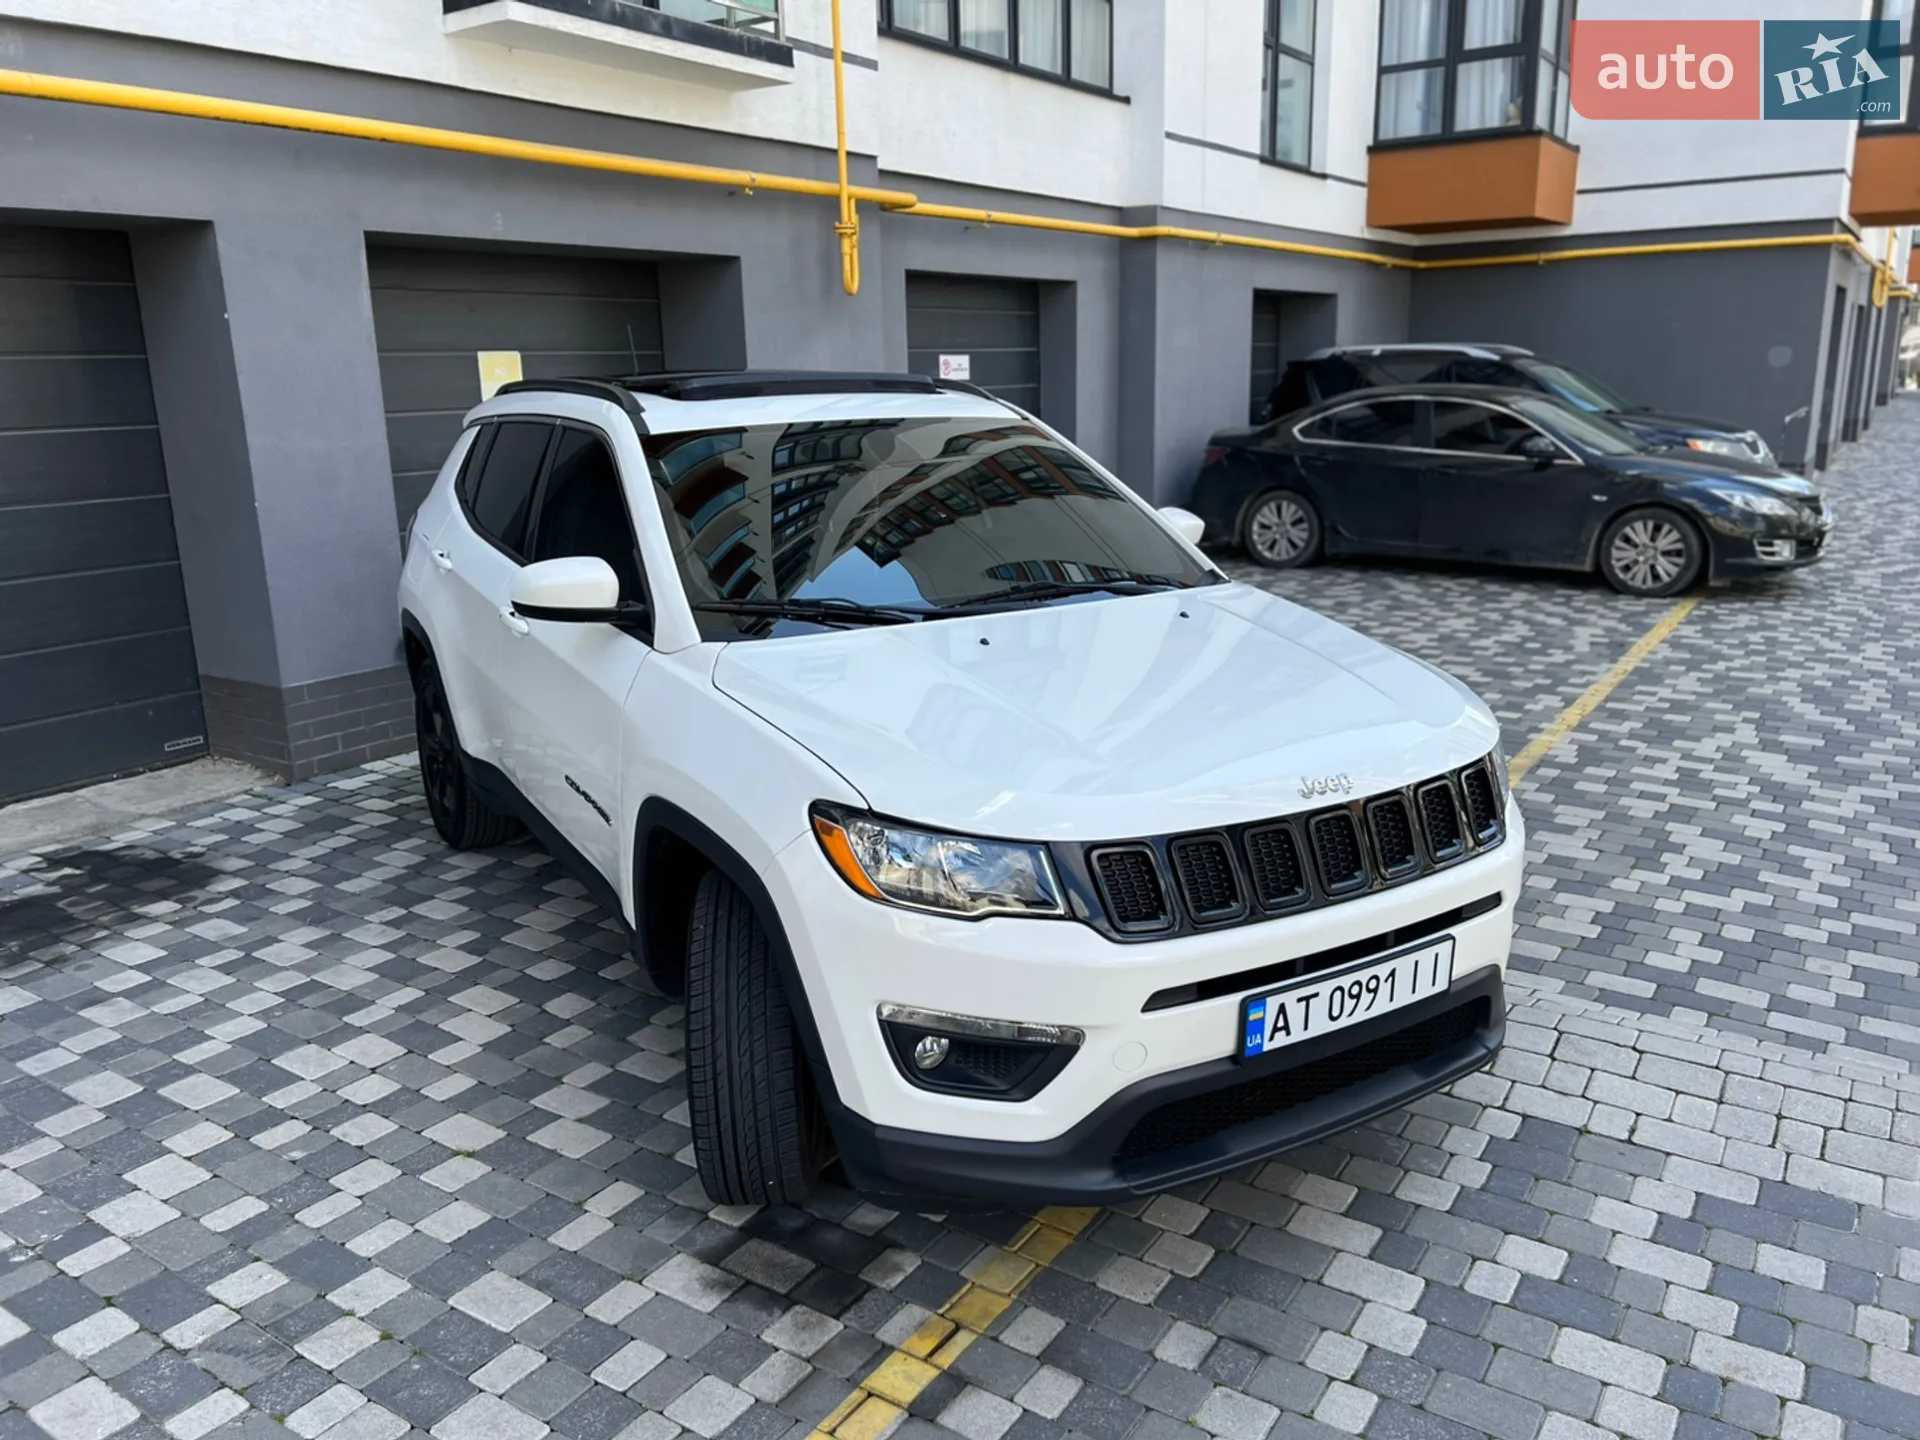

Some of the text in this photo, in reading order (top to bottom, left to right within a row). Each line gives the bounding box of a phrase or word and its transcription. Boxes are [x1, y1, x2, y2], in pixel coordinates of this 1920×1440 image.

[1297, 772, 1354, 799] Jeep
[1267, 992, 1320, 1043] AT
[1328, 967, 1397, 1022] 0991
[1246, 1033, 1263, 1047] UA
